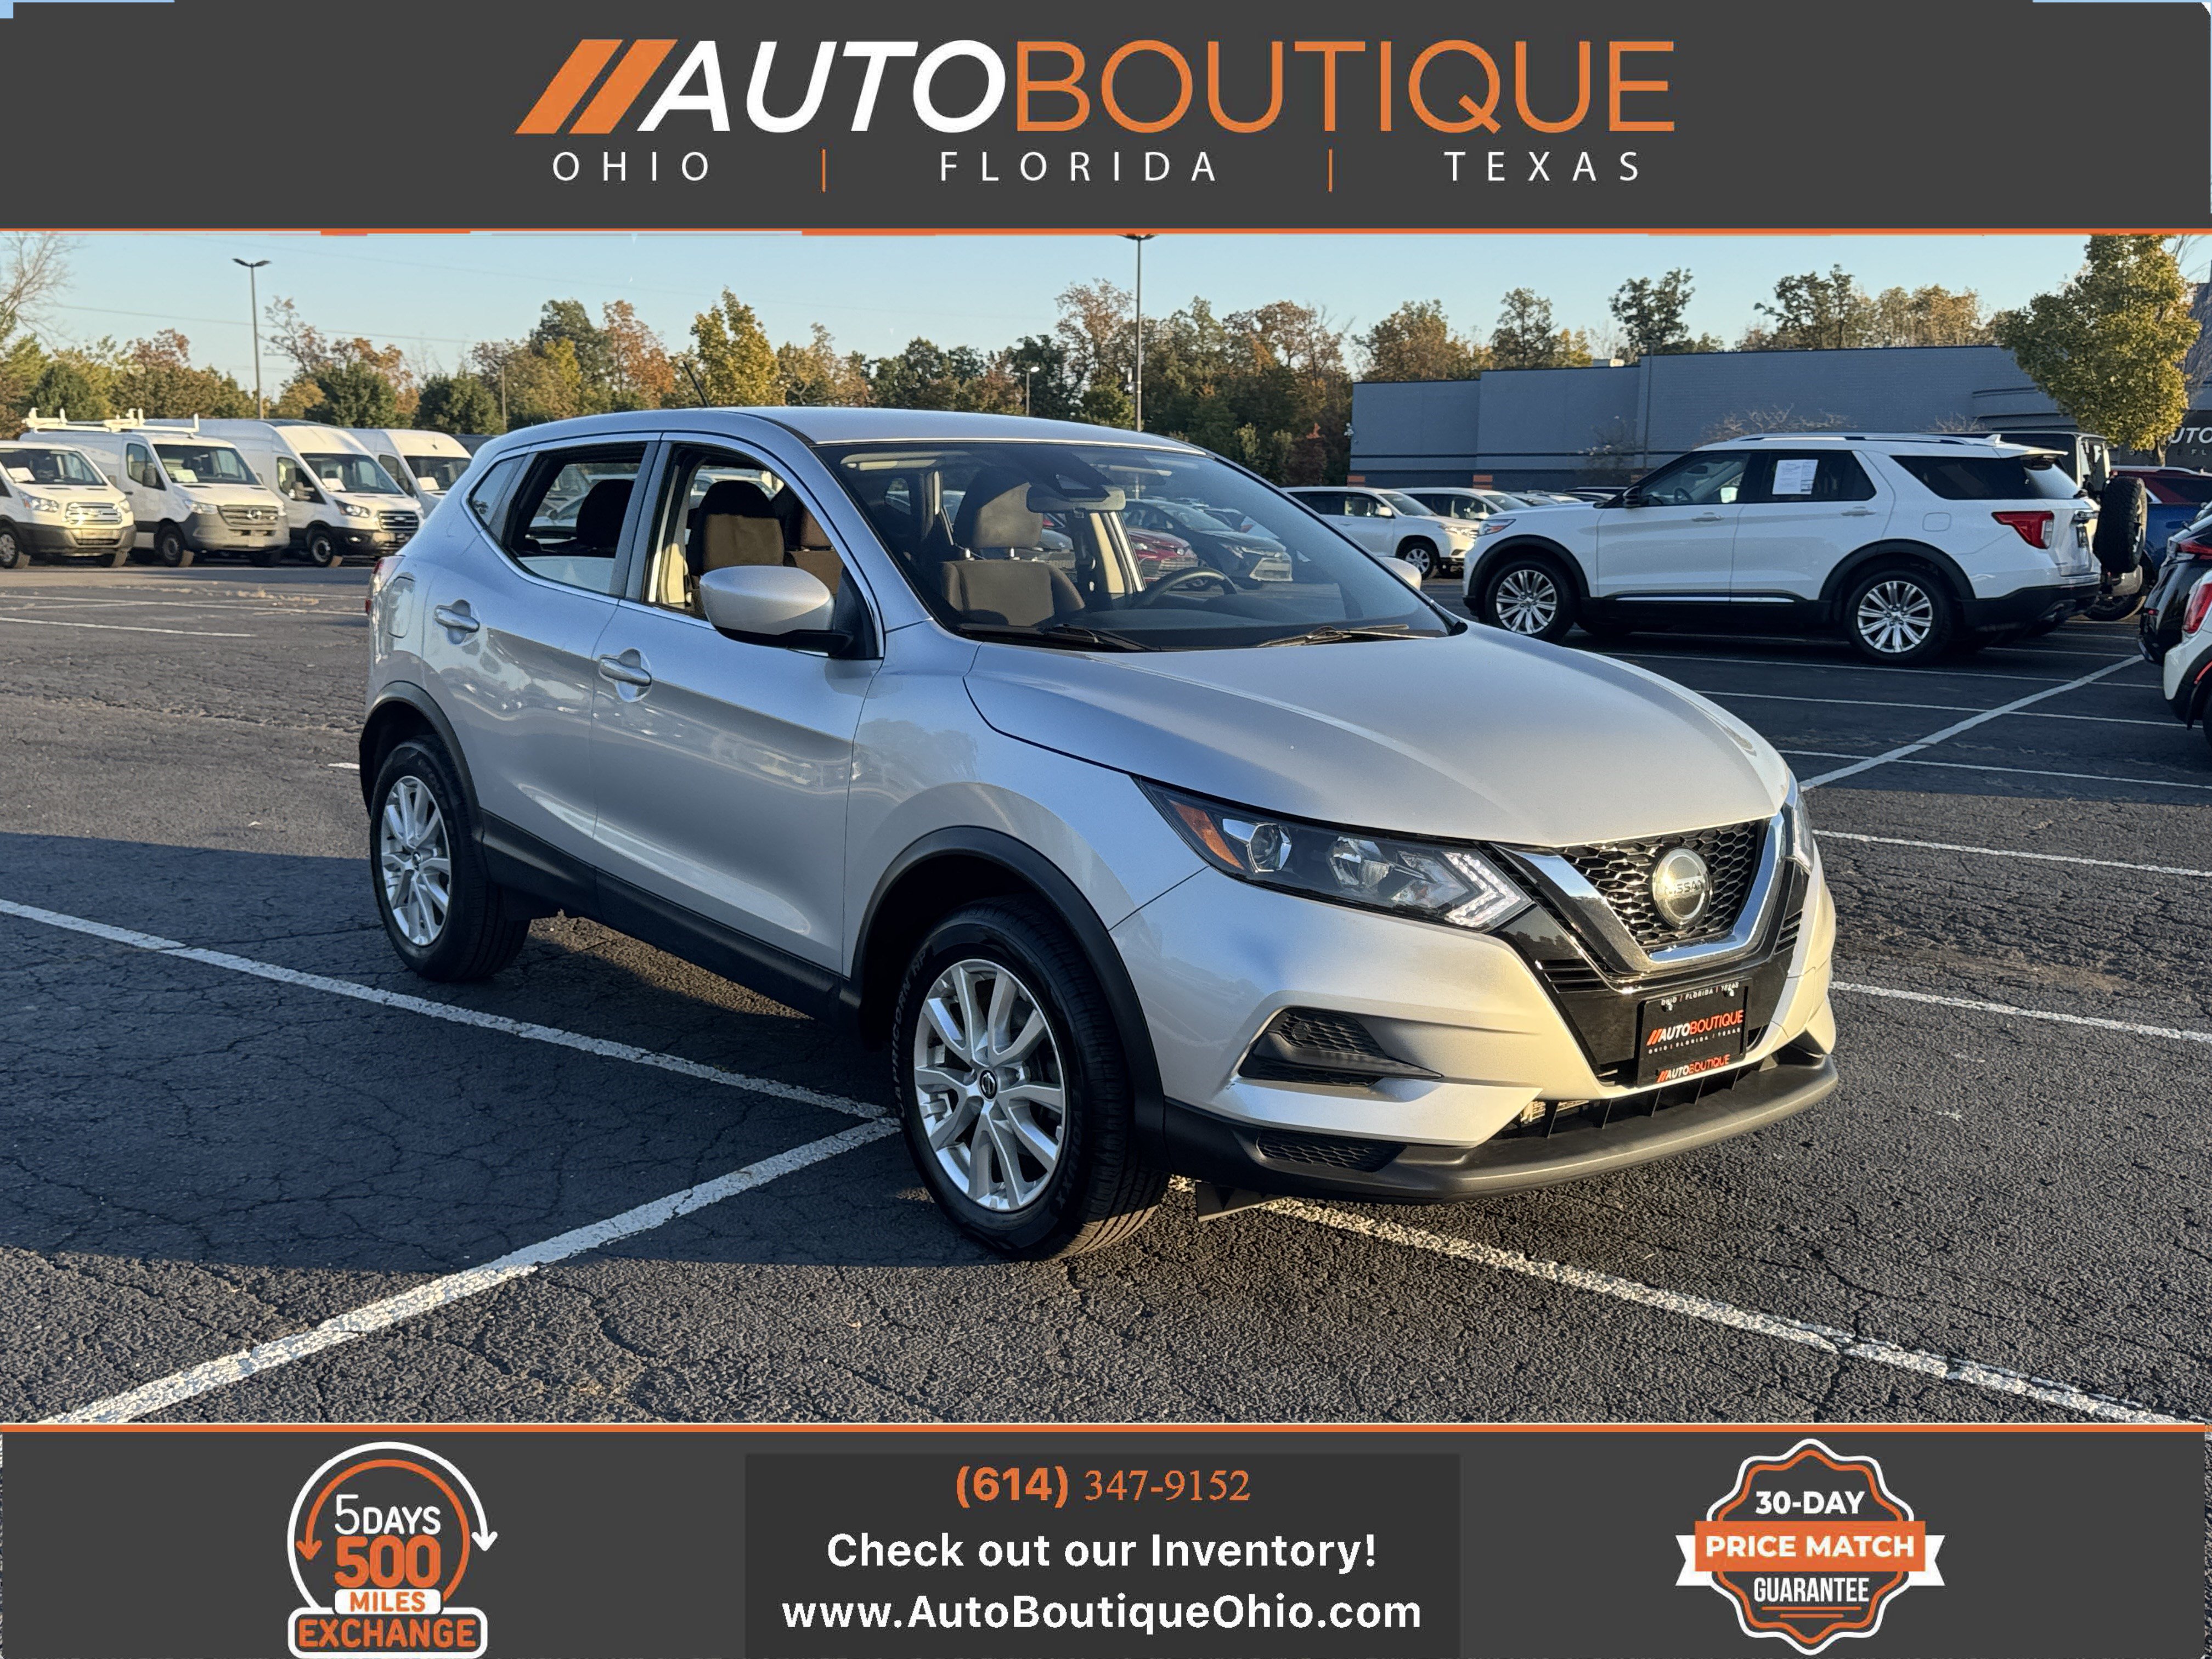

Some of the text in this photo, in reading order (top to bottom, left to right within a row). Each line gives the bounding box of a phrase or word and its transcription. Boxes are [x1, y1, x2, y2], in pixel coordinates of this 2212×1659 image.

[2168, 427, 2212, 444] UTO
[1661, 996, 1678, 1006] OHIO
[1685, 988, 1713, 1000] FLORIDA
[1657, 1009, 1744, 1042] AUTOBOUTIQUE
[1675, 1035, 1708, 1047] FLORIDA
[1664, 1054, 1731, 1080] AUTOBOUTIQUE
